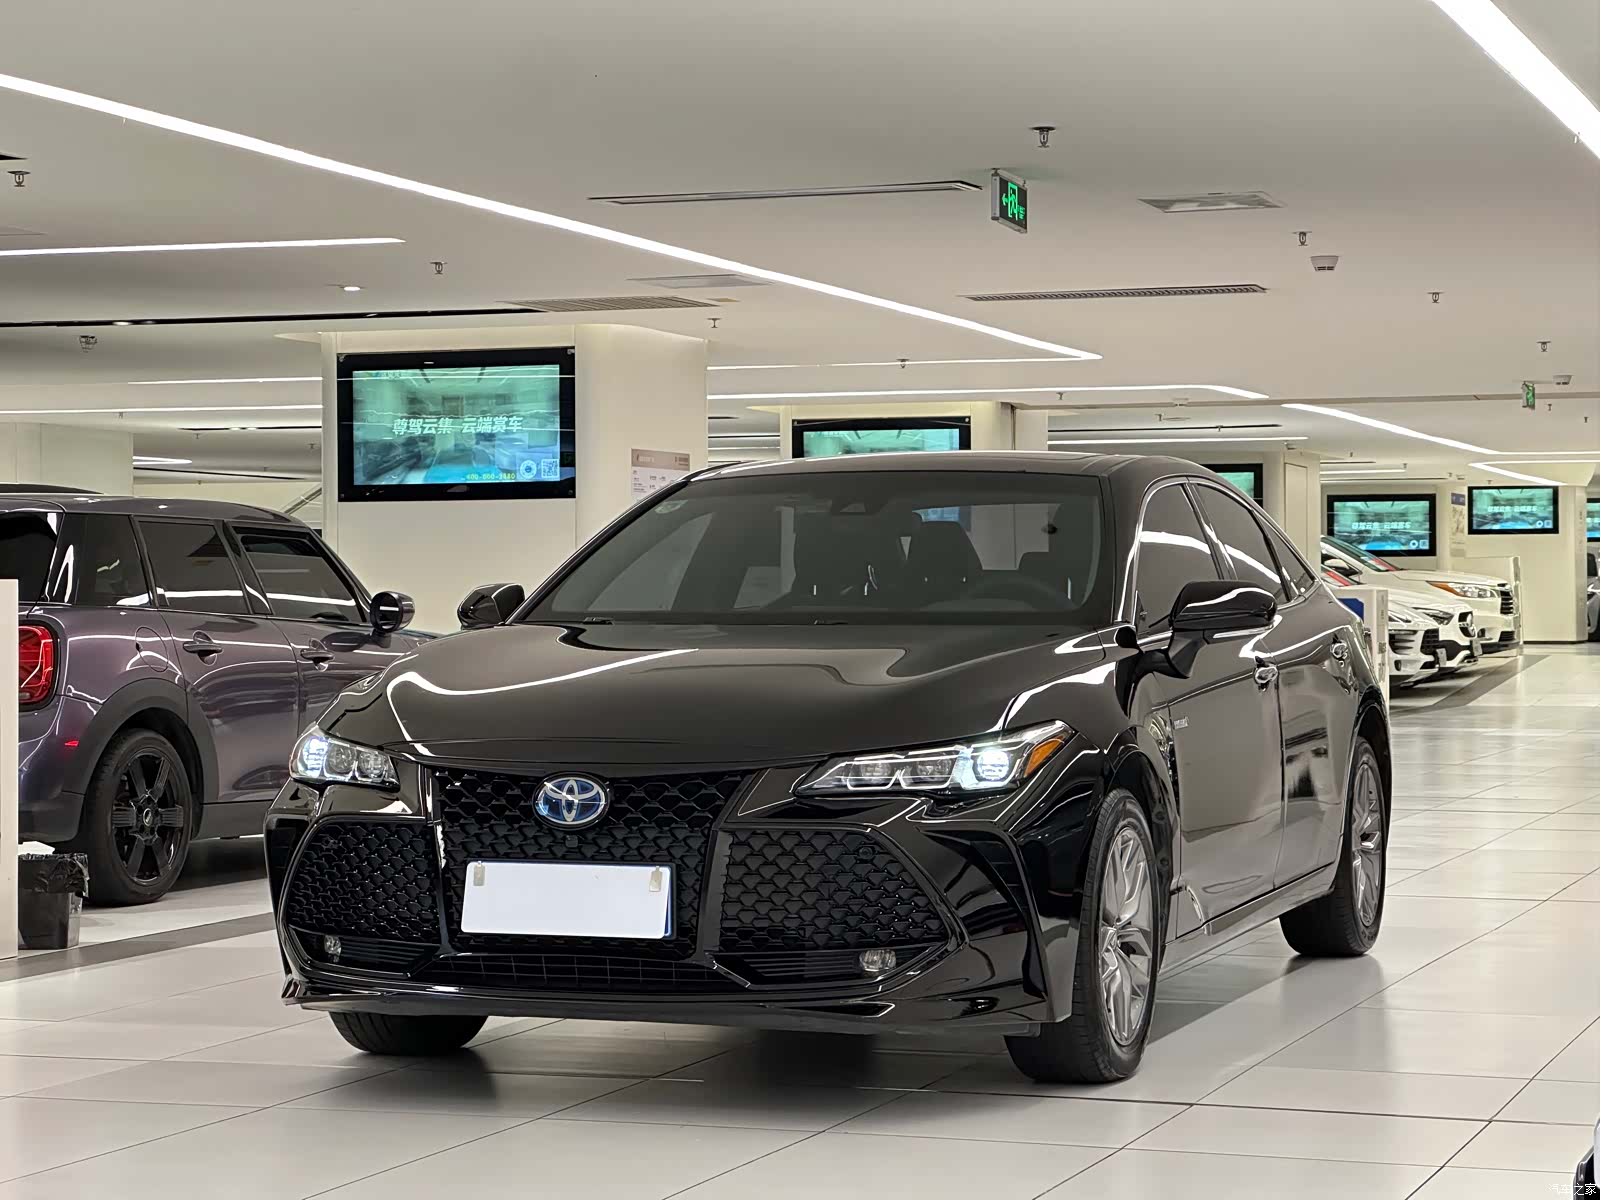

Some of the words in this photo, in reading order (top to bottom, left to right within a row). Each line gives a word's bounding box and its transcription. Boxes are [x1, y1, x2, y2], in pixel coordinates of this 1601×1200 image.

[392, 418, 453, 435] 尊驾云集
[461, 416, 524, 434] 云端赏车
